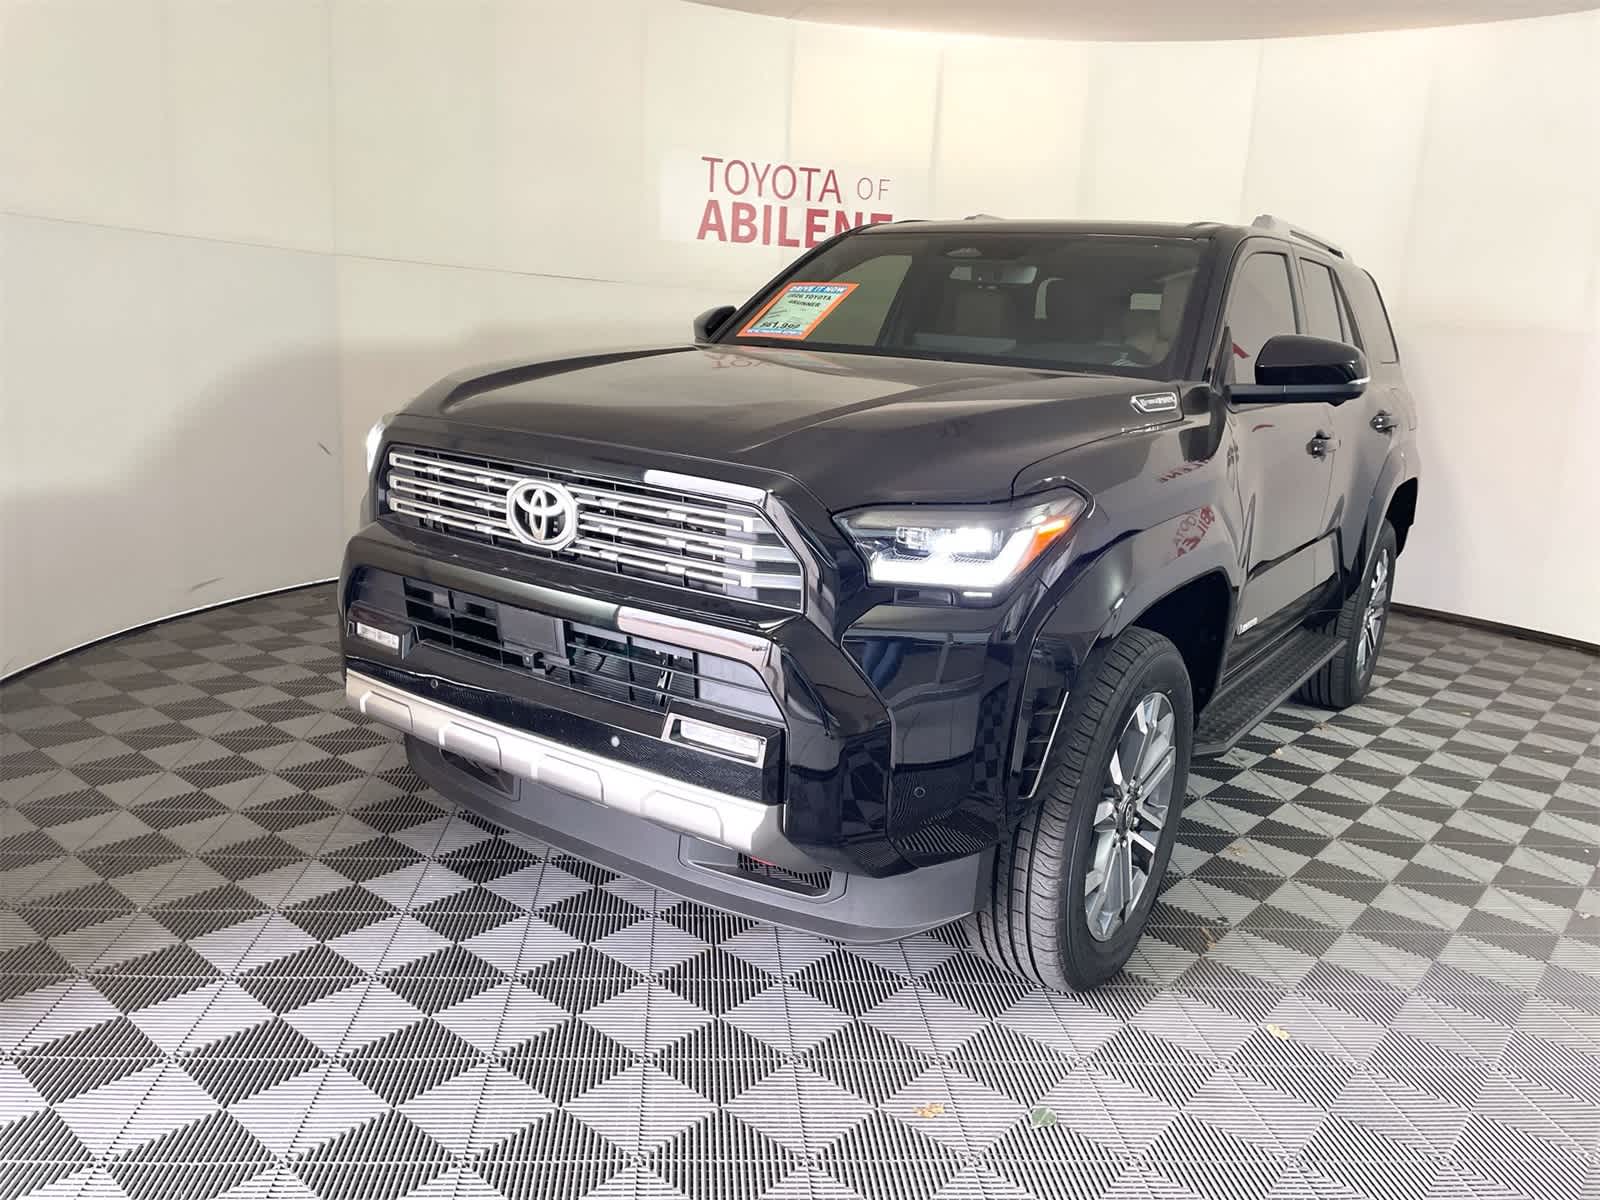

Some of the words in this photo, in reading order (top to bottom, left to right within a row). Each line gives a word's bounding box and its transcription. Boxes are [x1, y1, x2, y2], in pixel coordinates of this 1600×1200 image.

[702, 156, 842, 203] TOYOTA
[857, 177, 892, 200] OF
[696, 200, 893, 249] ABILEN
